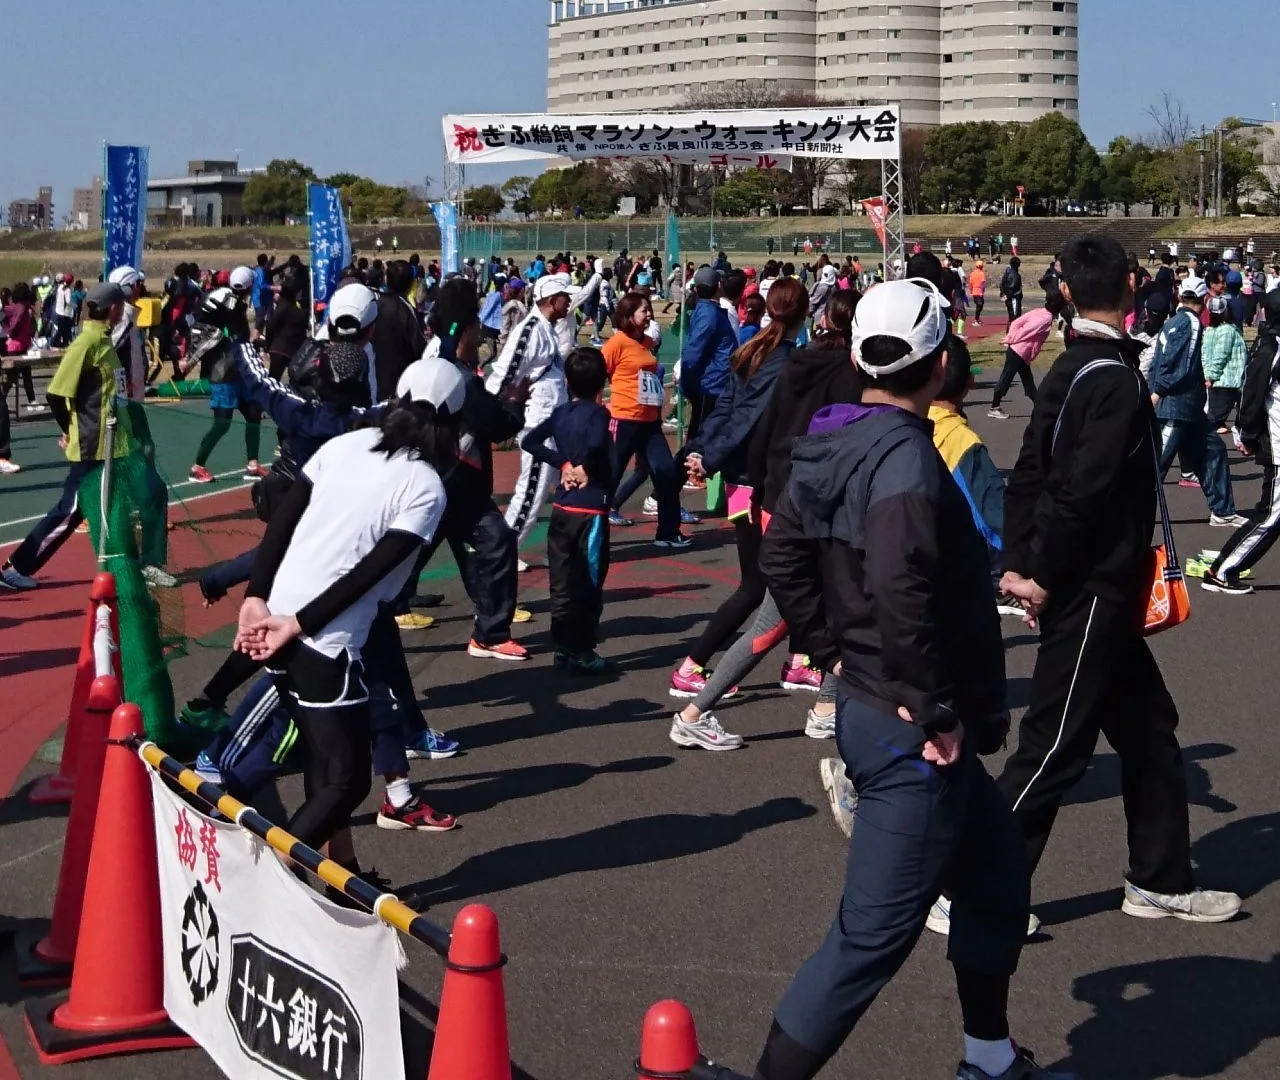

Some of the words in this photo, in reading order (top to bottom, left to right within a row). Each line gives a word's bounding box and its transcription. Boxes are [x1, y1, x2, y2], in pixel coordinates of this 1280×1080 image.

[174, 807, 222, 893] 協賛
[238, 958, 349, 1080] 十六銀行
